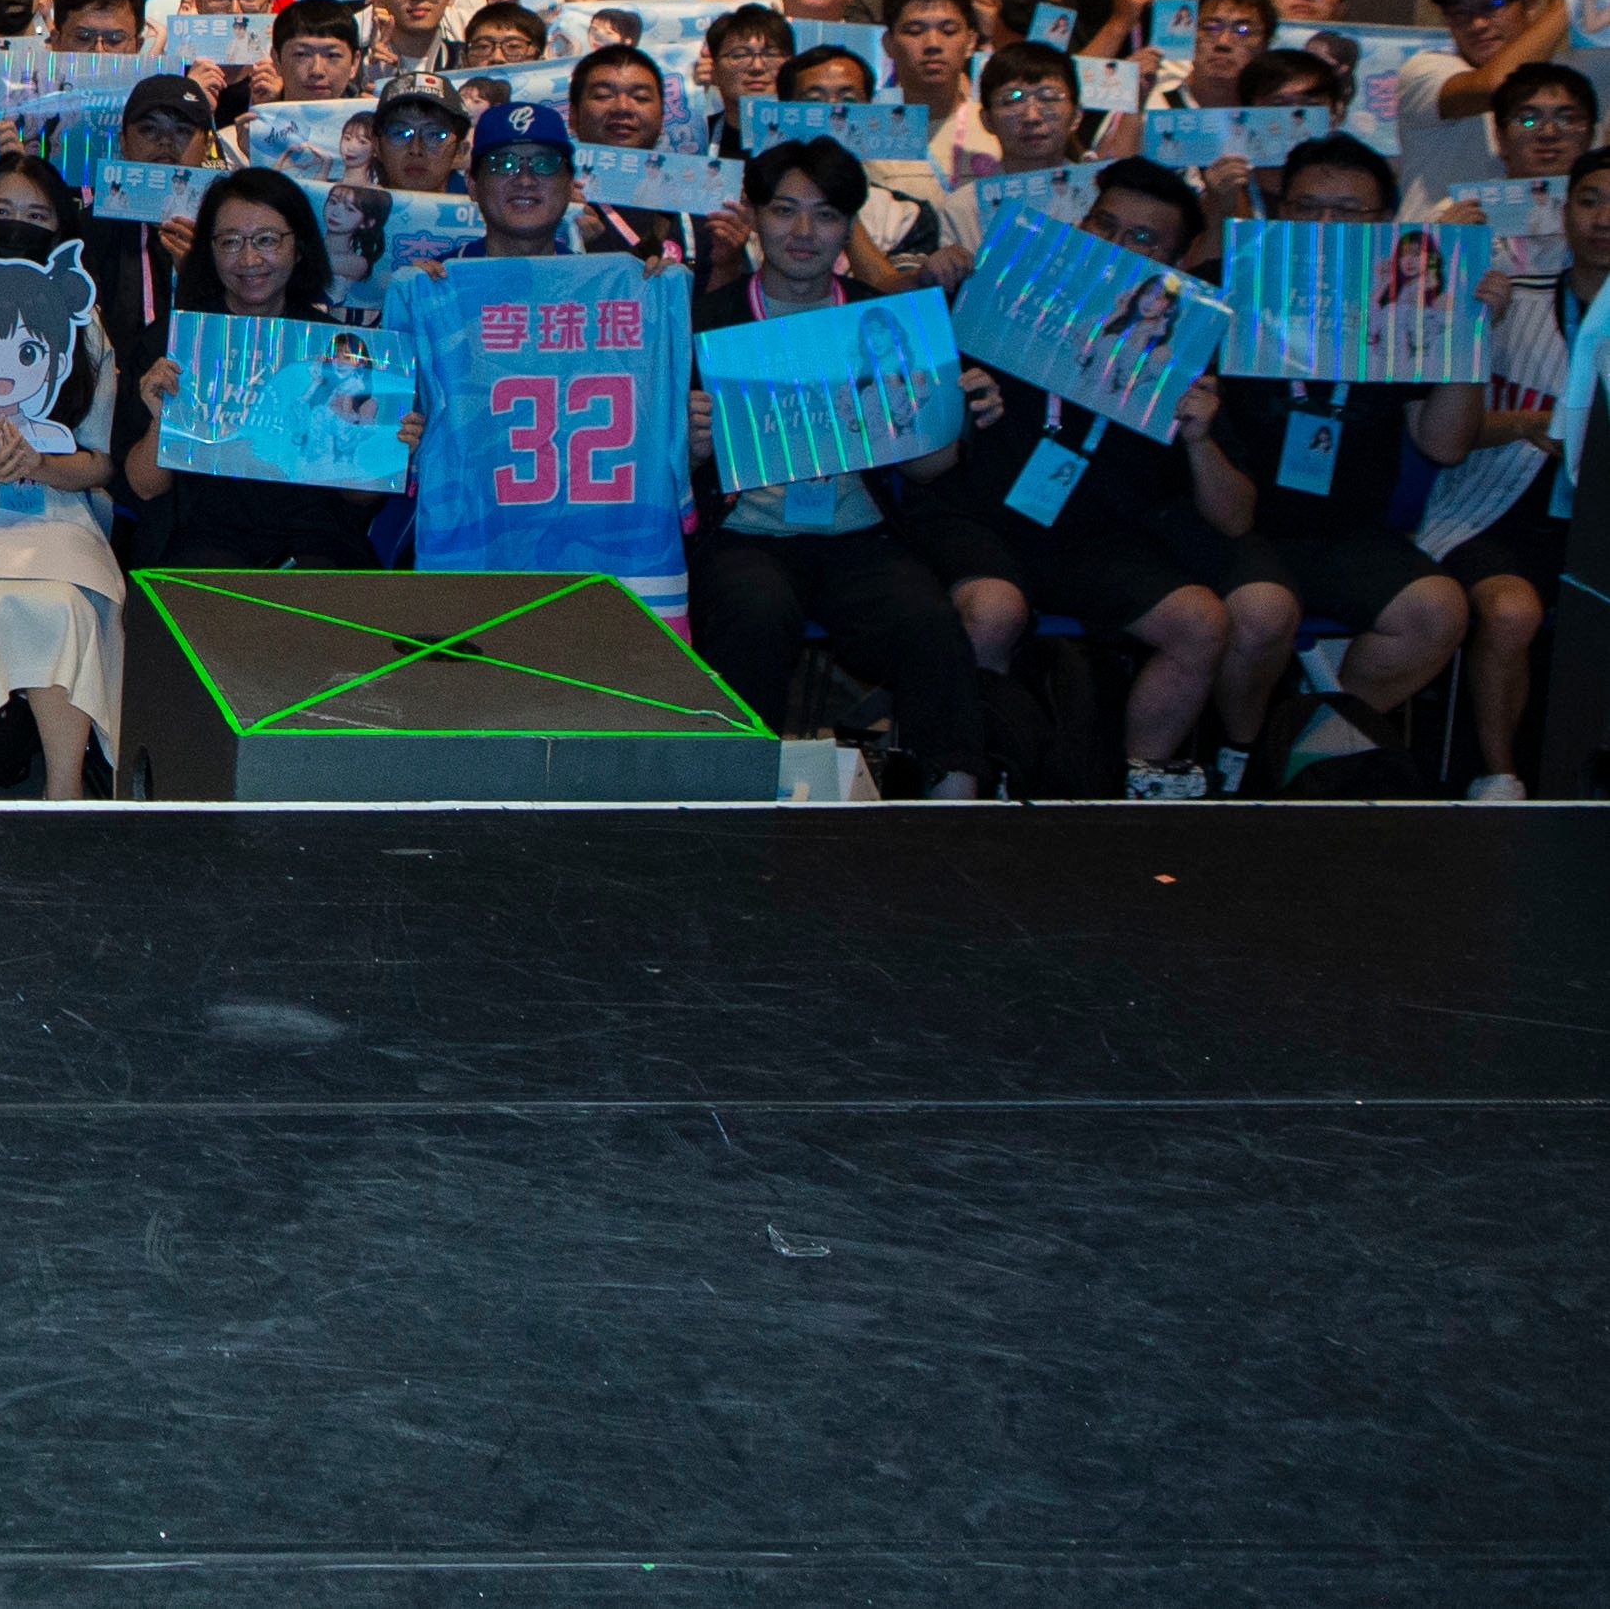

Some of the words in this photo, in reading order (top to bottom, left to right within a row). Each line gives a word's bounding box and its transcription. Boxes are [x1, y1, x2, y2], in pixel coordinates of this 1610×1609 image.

[482, 301, 644, 351] 李珠珢
[491, 374, 636, 505] 32
